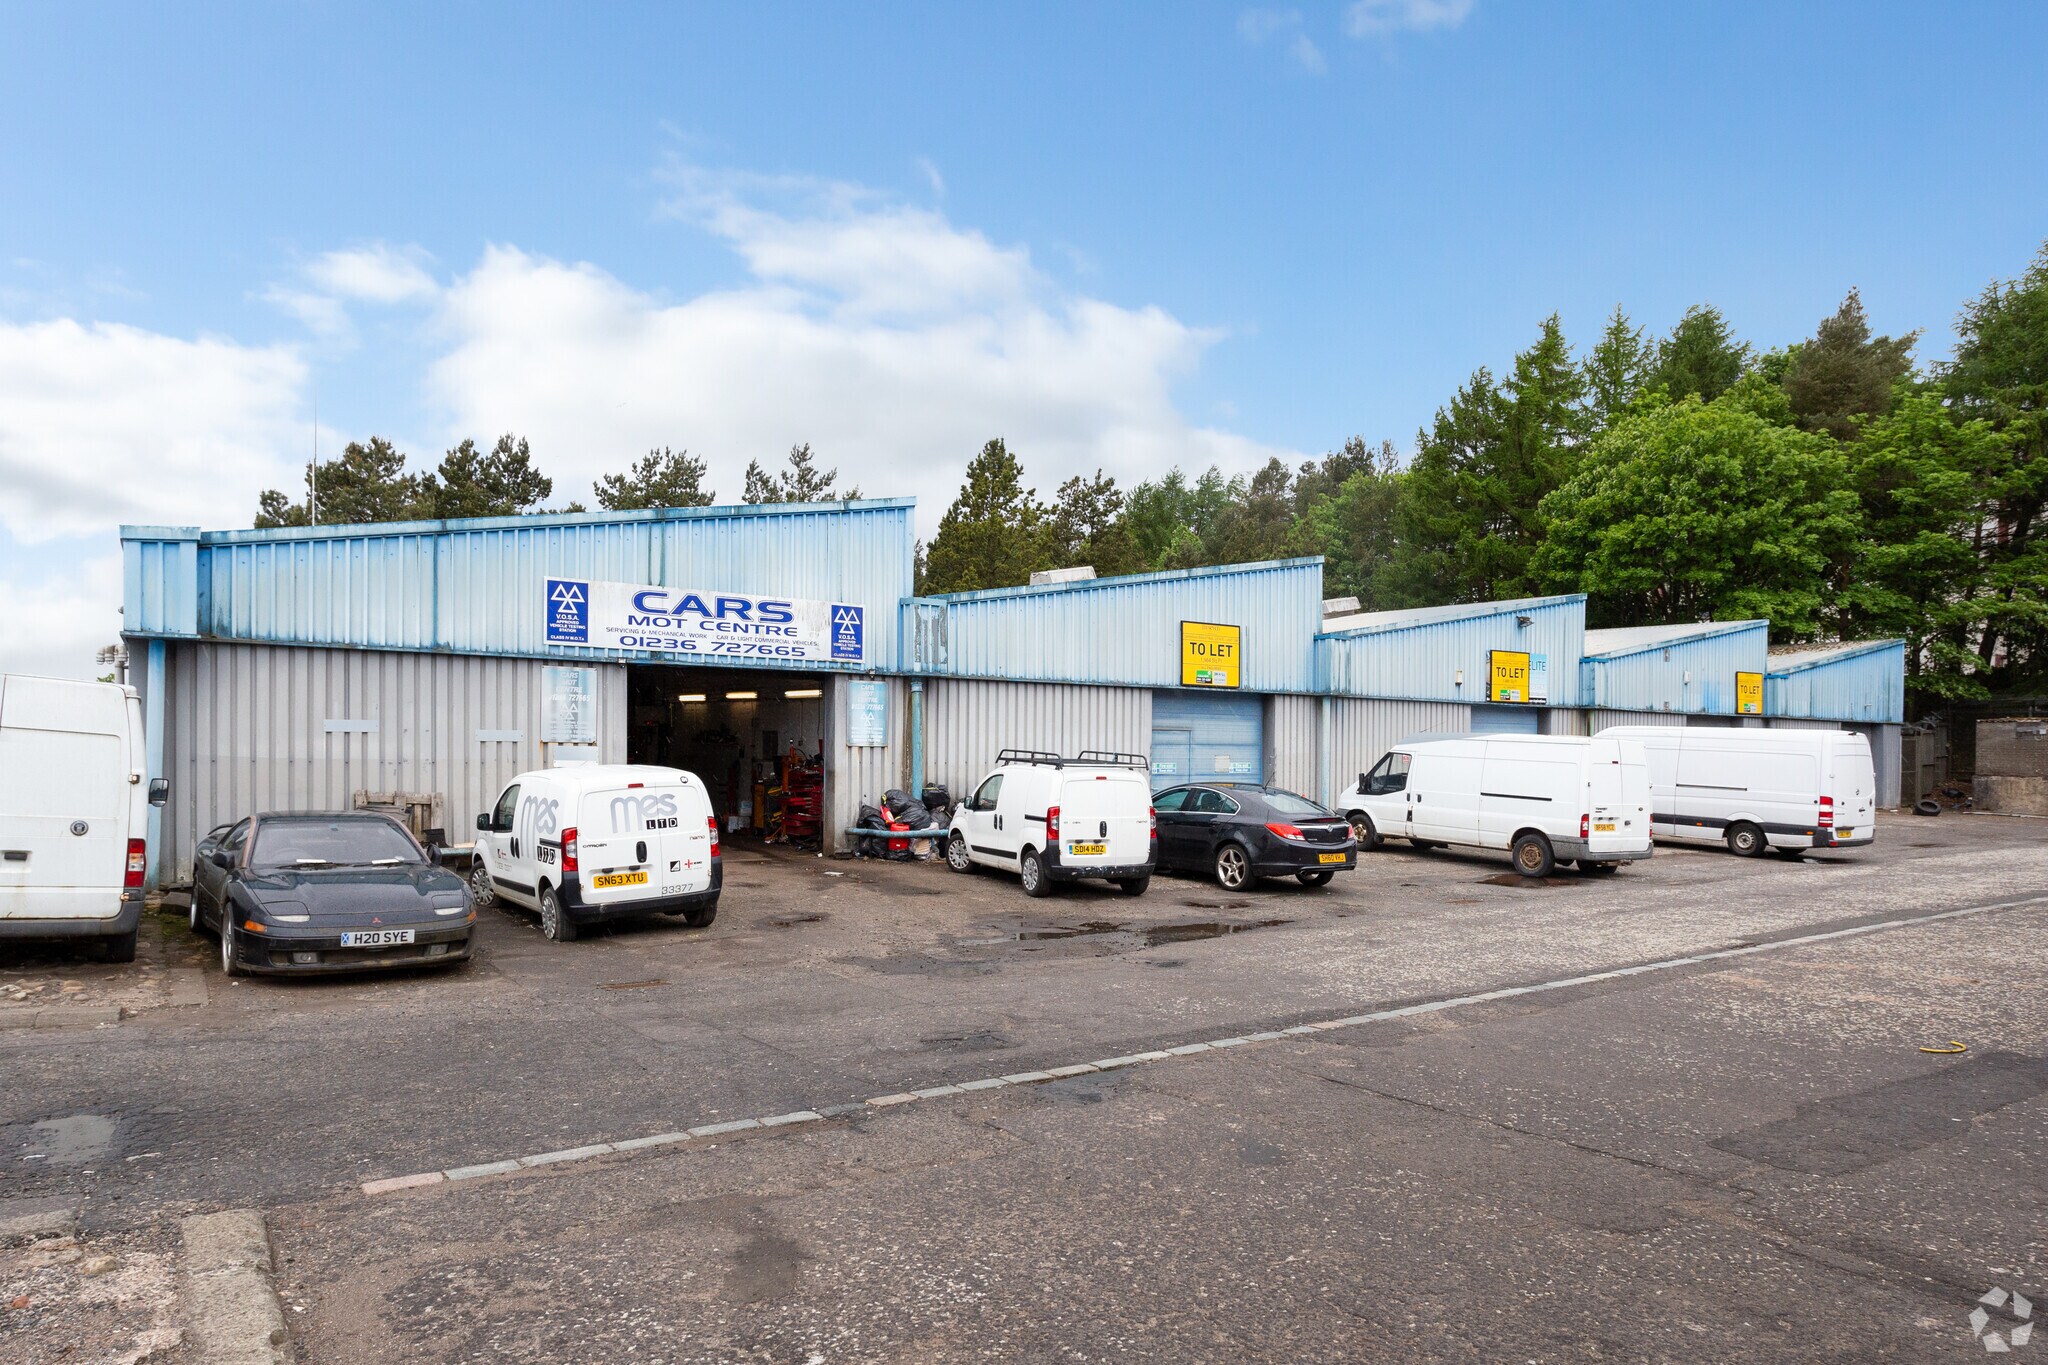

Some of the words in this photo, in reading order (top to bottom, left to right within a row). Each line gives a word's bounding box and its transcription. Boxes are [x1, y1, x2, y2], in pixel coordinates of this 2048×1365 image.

[632, 590, 794, 623] CARS
[606, 626, 640, 635] SERVICING
[648, 630, 687, 638] MECHANICAL
[628, 615, 687, 628] MOT
[699, 620, 797, 637] CENTRE
[619, 636, 697, 650] 01236
[710, 642, 805, 657] 727665
[754, 637, 791, 645] COMMERCIAL
[1190, 642, 1206, 656] TO
[1210, 643, 1233, 657] LET
[1496, 666, 1507, 678] TO
[1509, 667, 1525, 679] LET
[1740, 684, 1748, 694] TO
[1749, 685, 1760, 695] LET
[610, 793, 678, 834] mes
[647, 817, 678, 830] LTD
[537, 845, 556, 865] LTD
[1074, 845, 1090, 853] SD14
[597, 874, 624, 887] SN63
[625, 872, 645, 884] XTU
[661, 883, 694, 895] 33377
[354, 932, 380, 945] H20
[384, 931, 409, 943] SYE
